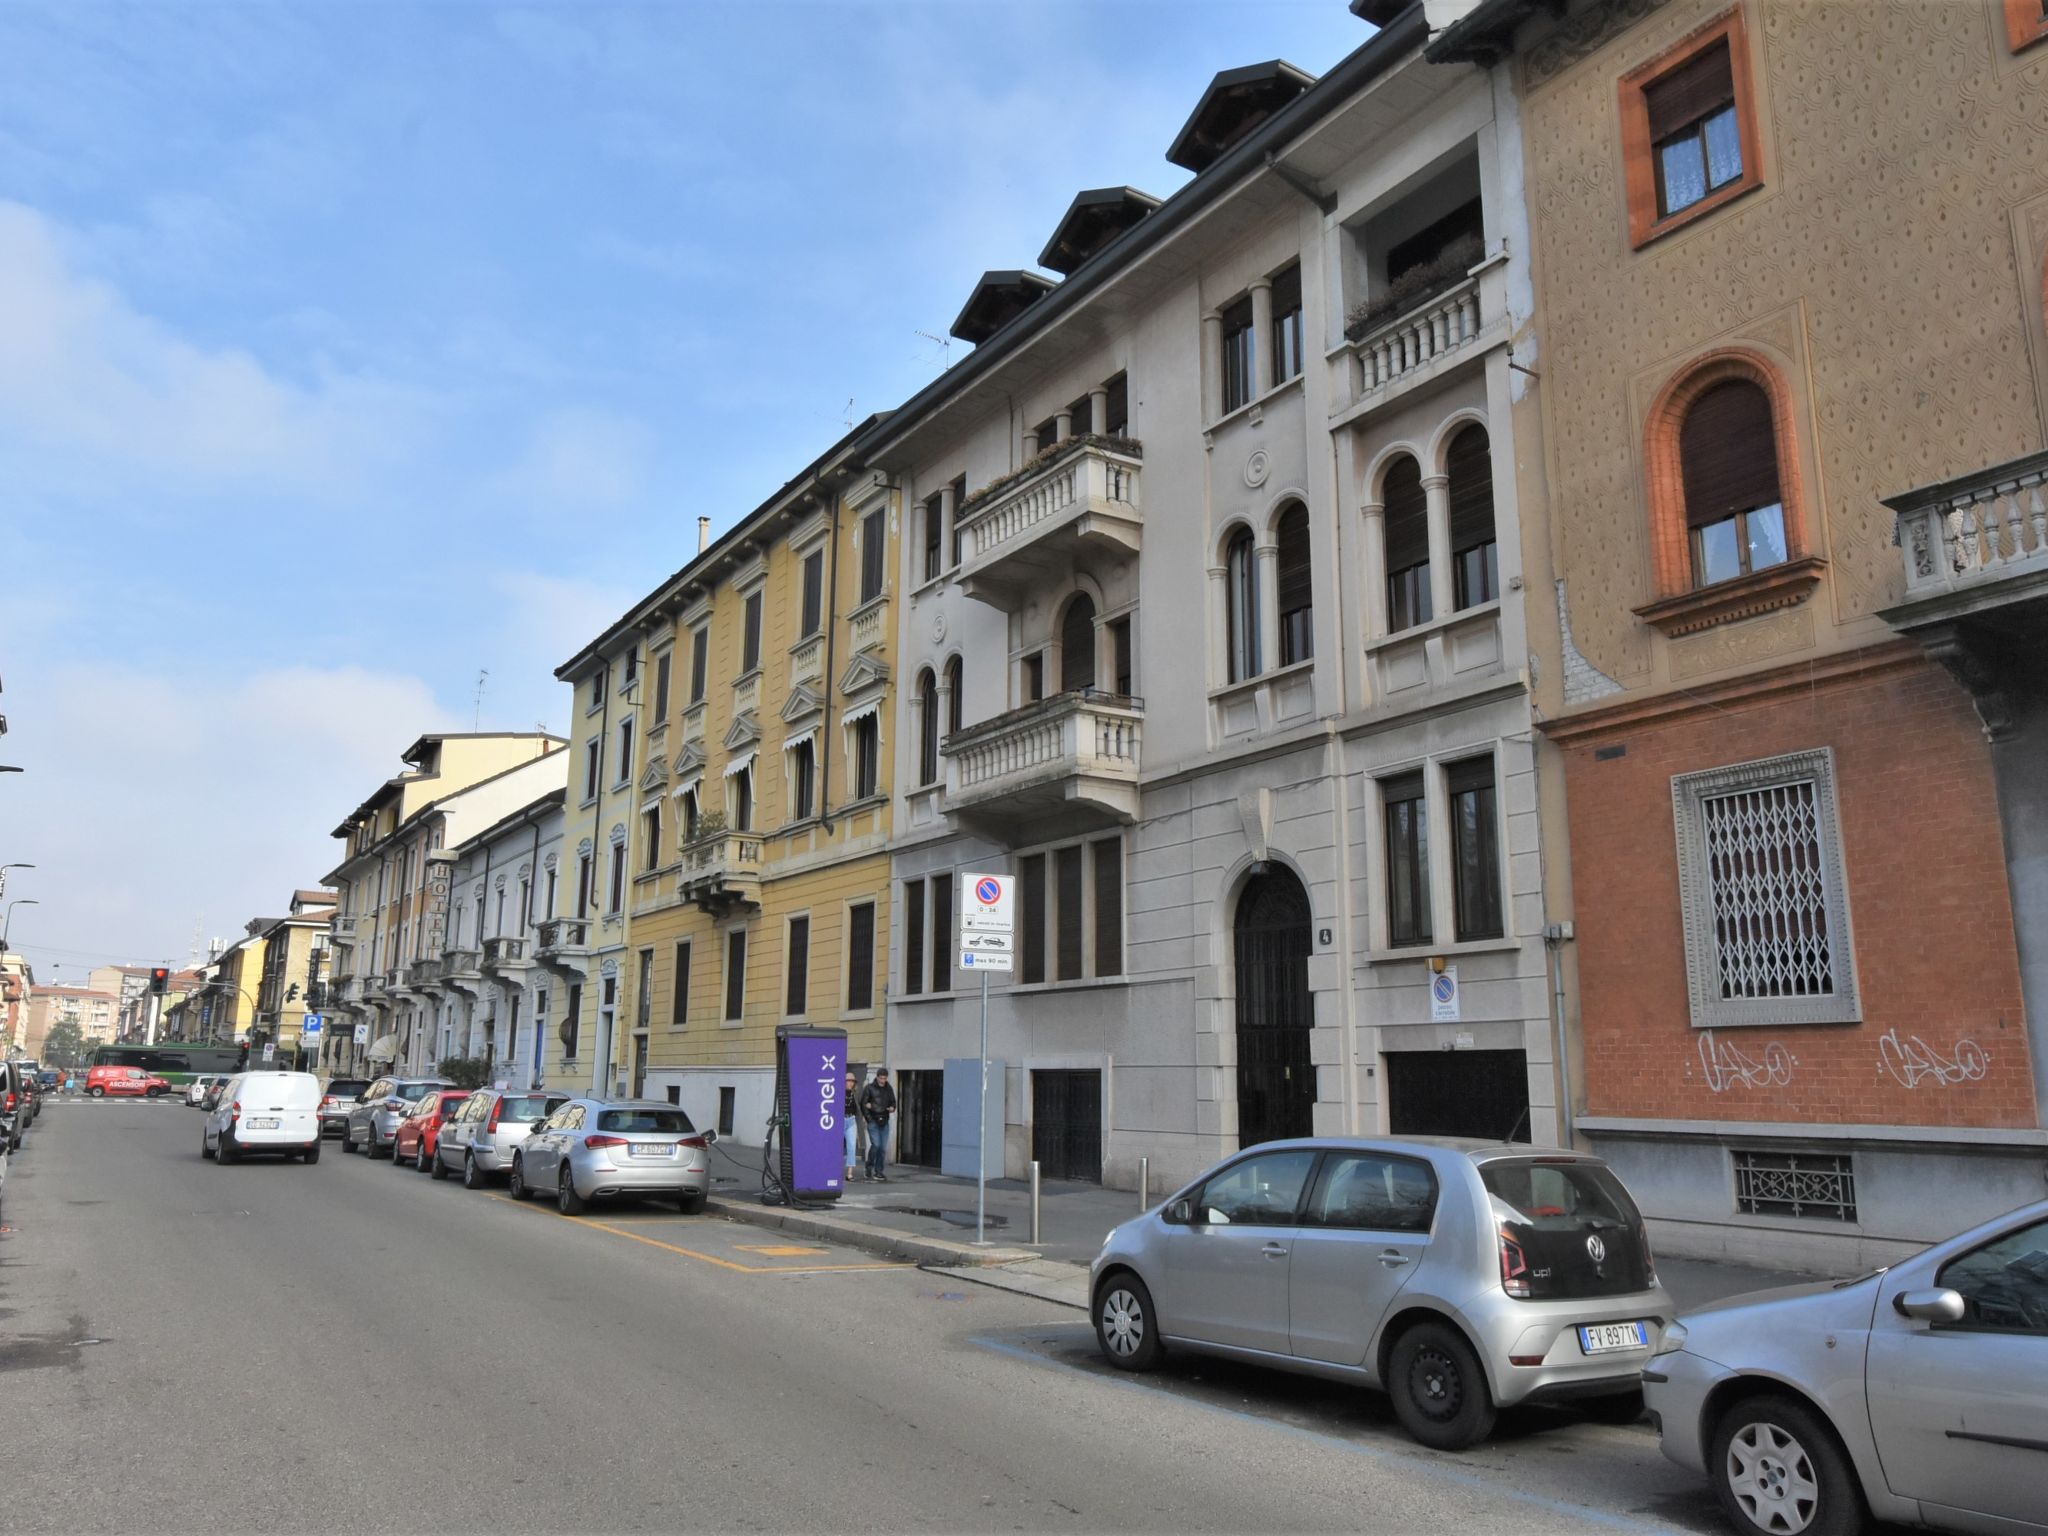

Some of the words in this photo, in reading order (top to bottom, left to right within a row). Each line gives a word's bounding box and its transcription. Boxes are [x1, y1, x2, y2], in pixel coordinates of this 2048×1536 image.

[432, 866, 447, 947] HOTEL
[307, 1017, 318, 1029] P
[818, 1077, 836, 1130] enel
[1533, 1267, 1551, 1279] up!
